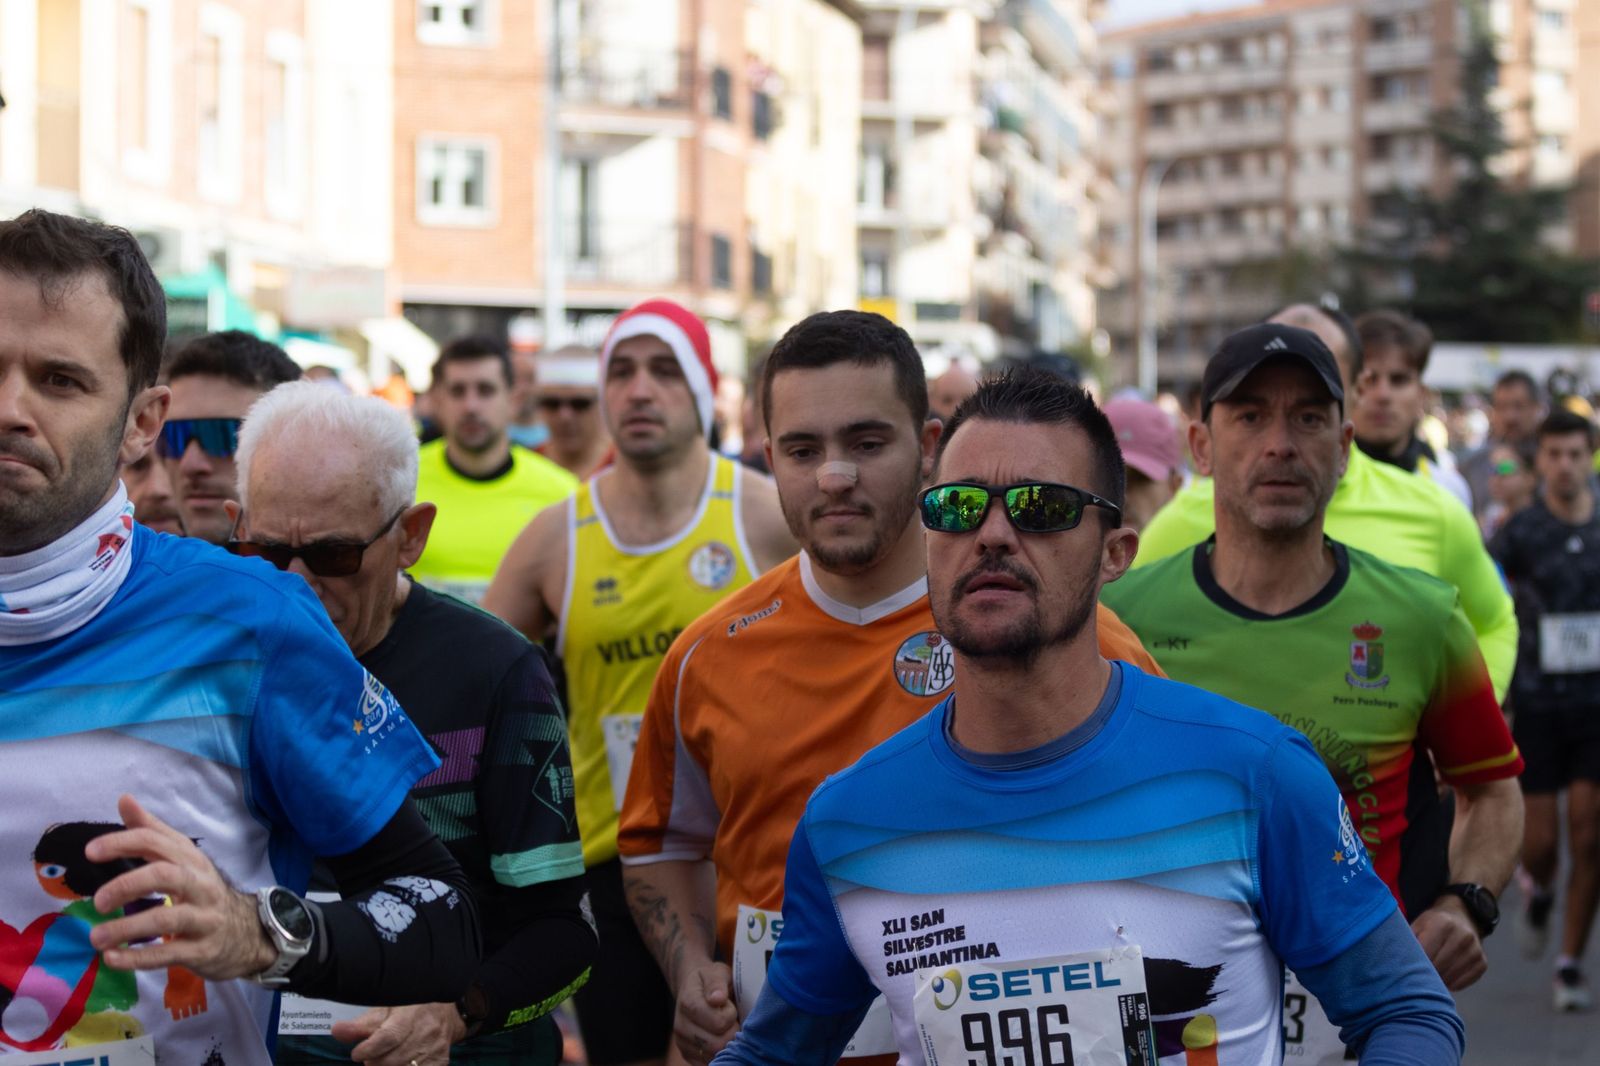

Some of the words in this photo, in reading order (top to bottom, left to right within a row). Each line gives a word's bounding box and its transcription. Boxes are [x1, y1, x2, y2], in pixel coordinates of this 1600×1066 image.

[596, 628, 684, 665] VILLO
[882, 918, 906, 936] XLI
[910, 909, 945, 931] SAN
[884, 925, 966, 957] SILVESTRE
[886, 942, 1001, 977] SALMANTINA
[968, 961, 1121, 1001] SETEL
[281, 1010, 332, 1021] Ayuntamiento
[281, 1021, 289, 1030] de
[291, 1021, 331, 1031] Salamanca
[1138, 1003, 1148, 1021] 996
[960, 1003, 1076, 1066] 996
